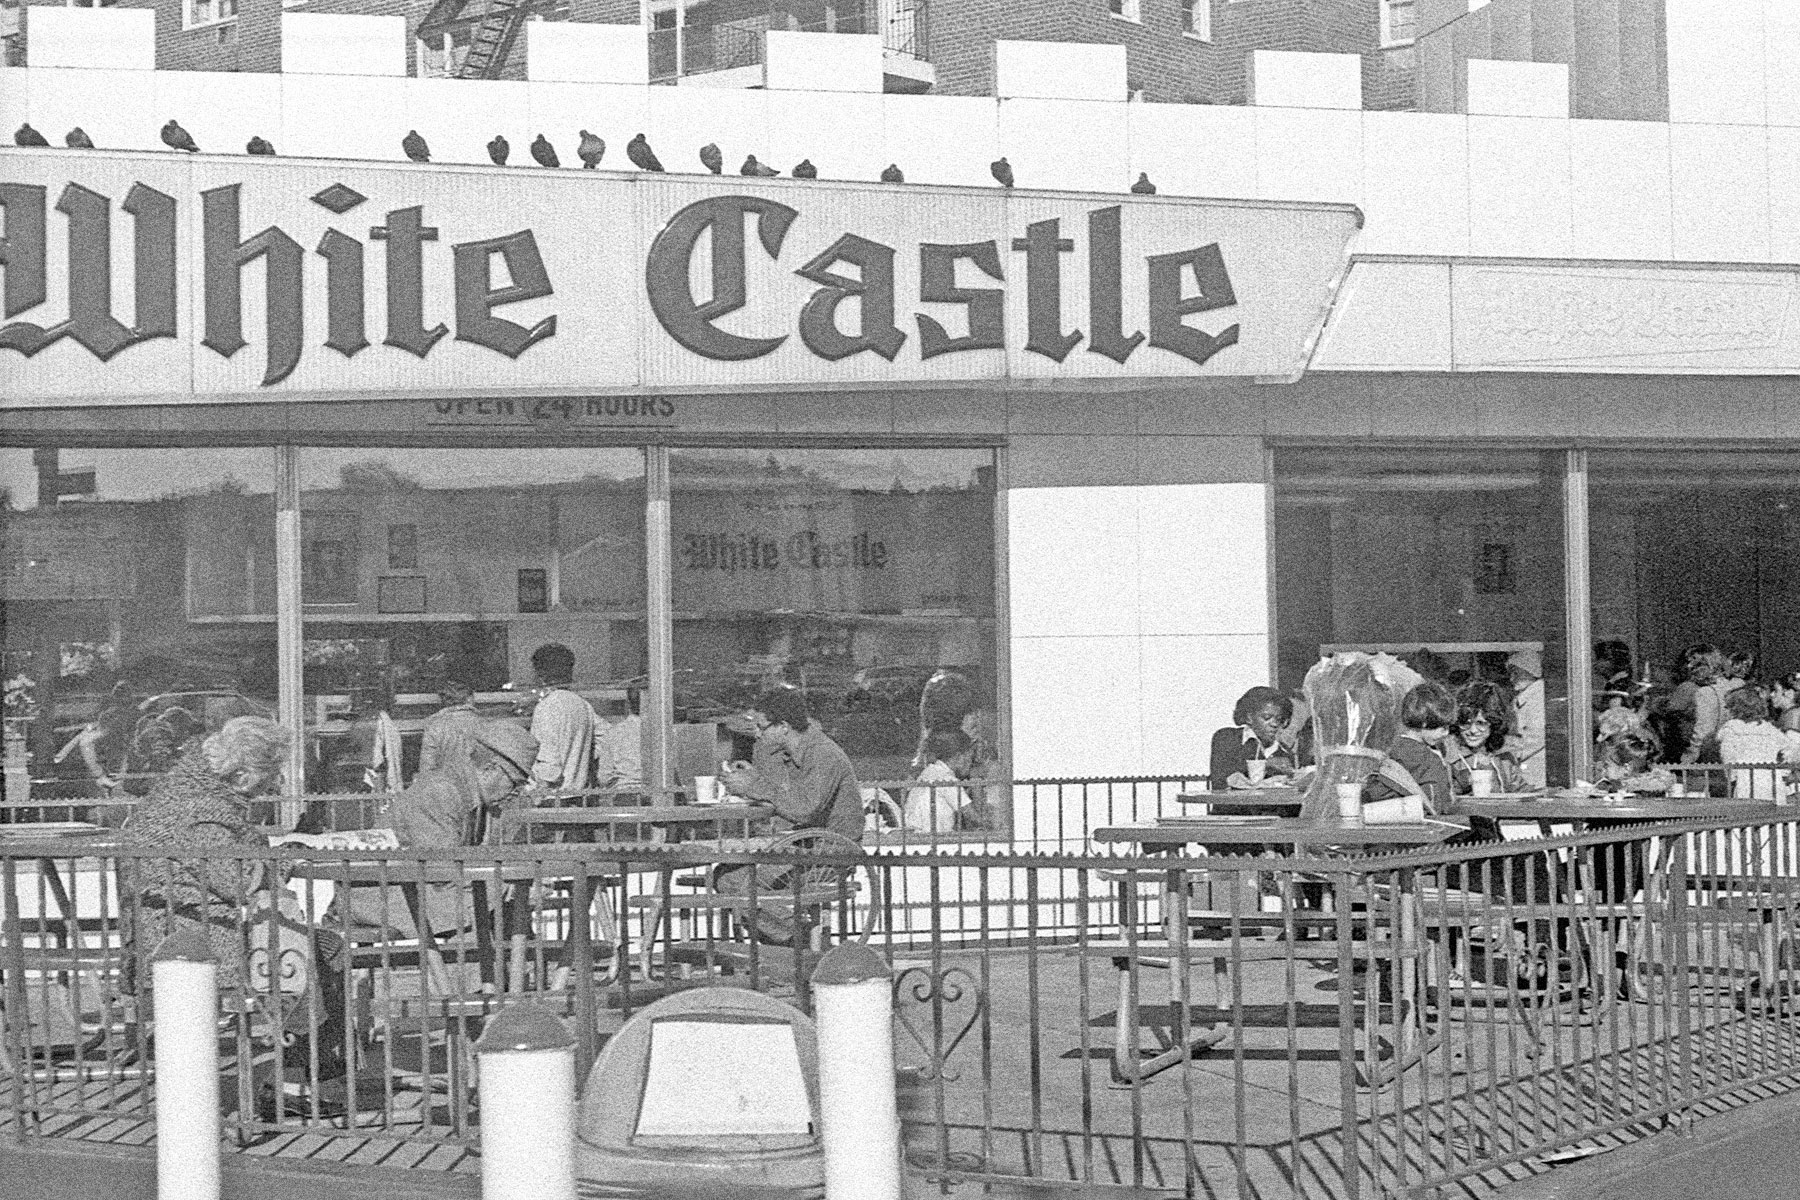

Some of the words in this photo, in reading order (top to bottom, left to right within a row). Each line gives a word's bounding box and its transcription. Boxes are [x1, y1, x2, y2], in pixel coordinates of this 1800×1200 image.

[0, 181, 557, 387] White
[645, 194, 1239, 366] Castle
[532, 398, 574, 419] 24
[586, 397, 675, 417] HOURS
